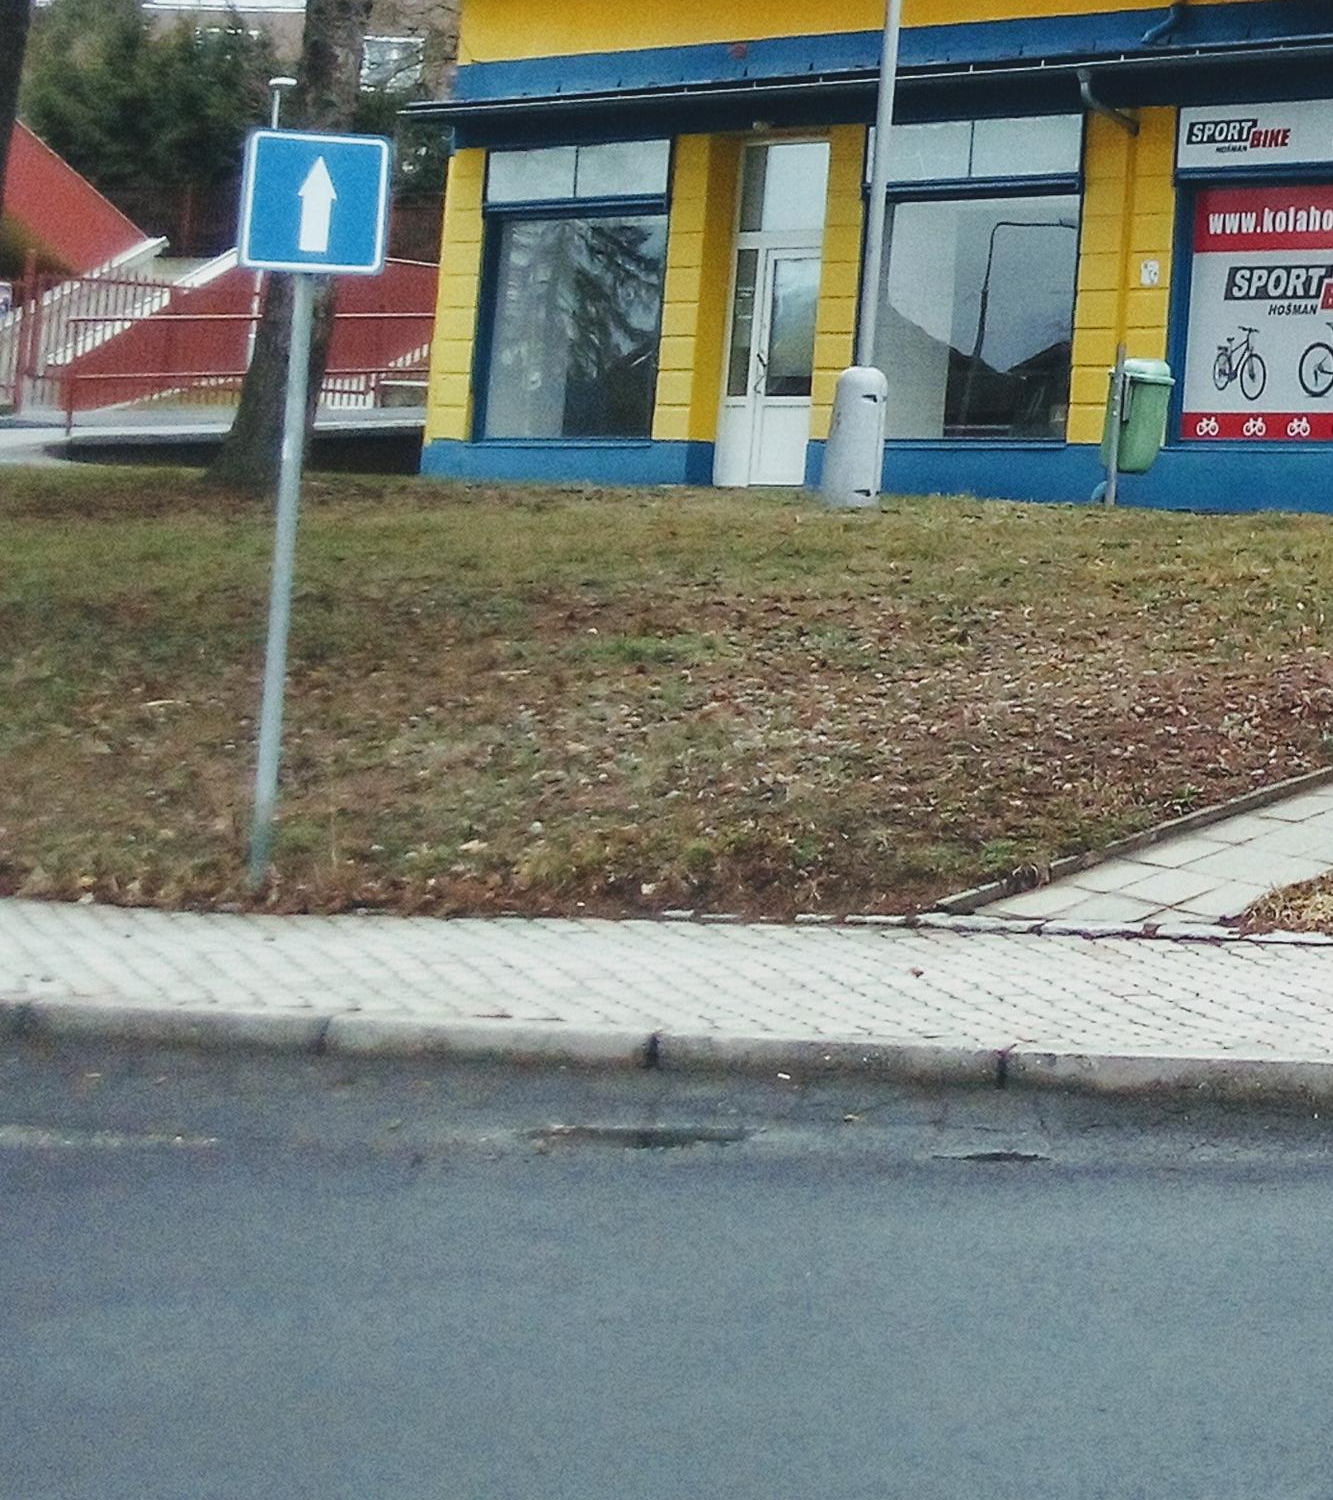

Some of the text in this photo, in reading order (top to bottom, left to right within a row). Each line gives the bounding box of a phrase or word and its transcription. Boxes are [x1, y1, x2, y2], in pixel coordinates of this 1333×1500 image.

[1191, 121, 1291, 148] SPORT BIKE
[1232, 268, 1326, 297] SPORT
[1268, 303, 1318, 316] HOŠMAN
